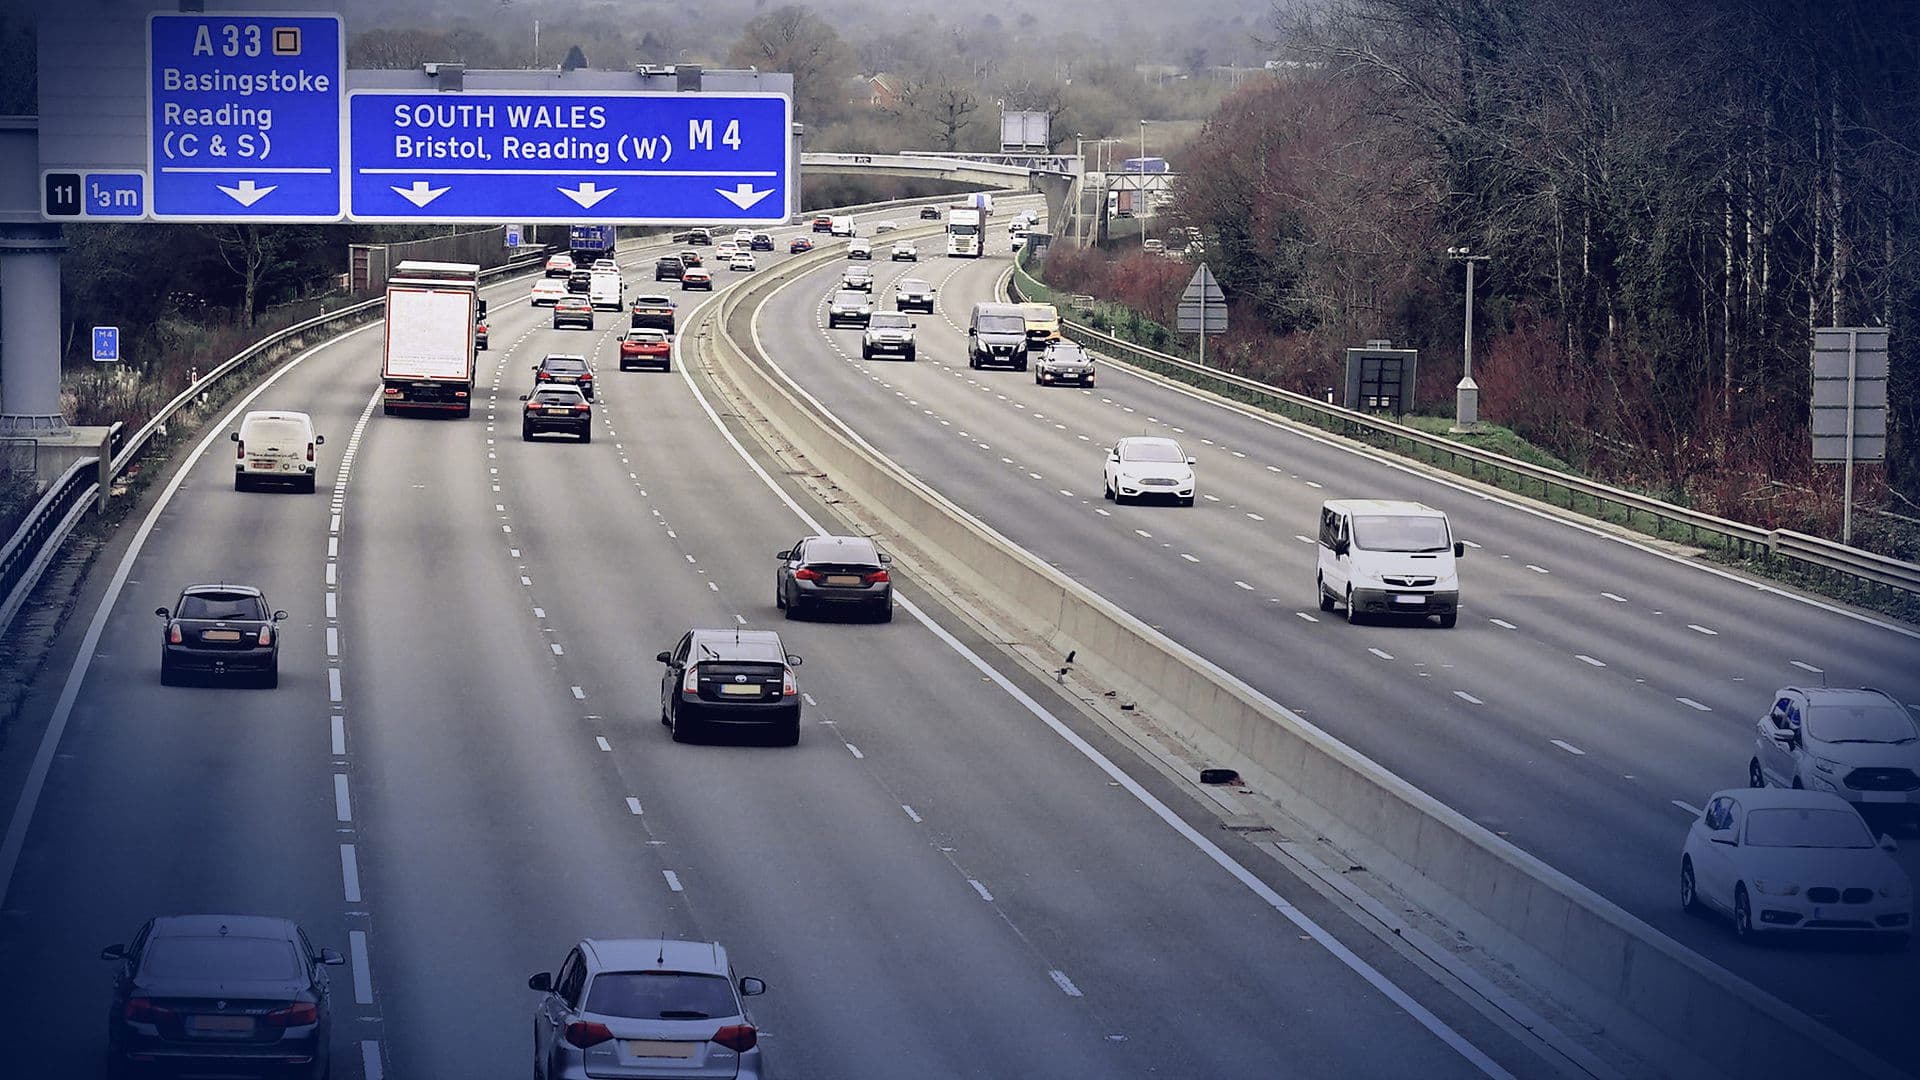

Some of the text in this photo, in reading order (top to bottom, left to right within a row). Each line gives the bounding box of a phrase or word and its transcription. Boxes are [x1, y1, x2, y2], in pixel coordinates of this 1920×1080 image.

[163, 68, 330, 96] Basingstoke
[163, 103, 273, 131] Reading
[393, 104, 607, 129] SOUTH WALES
[208, 134, 228, 158] &
[395, 134, 673, 165] Bristol, Reading (W)
[54, 185, 74, 205] 11
